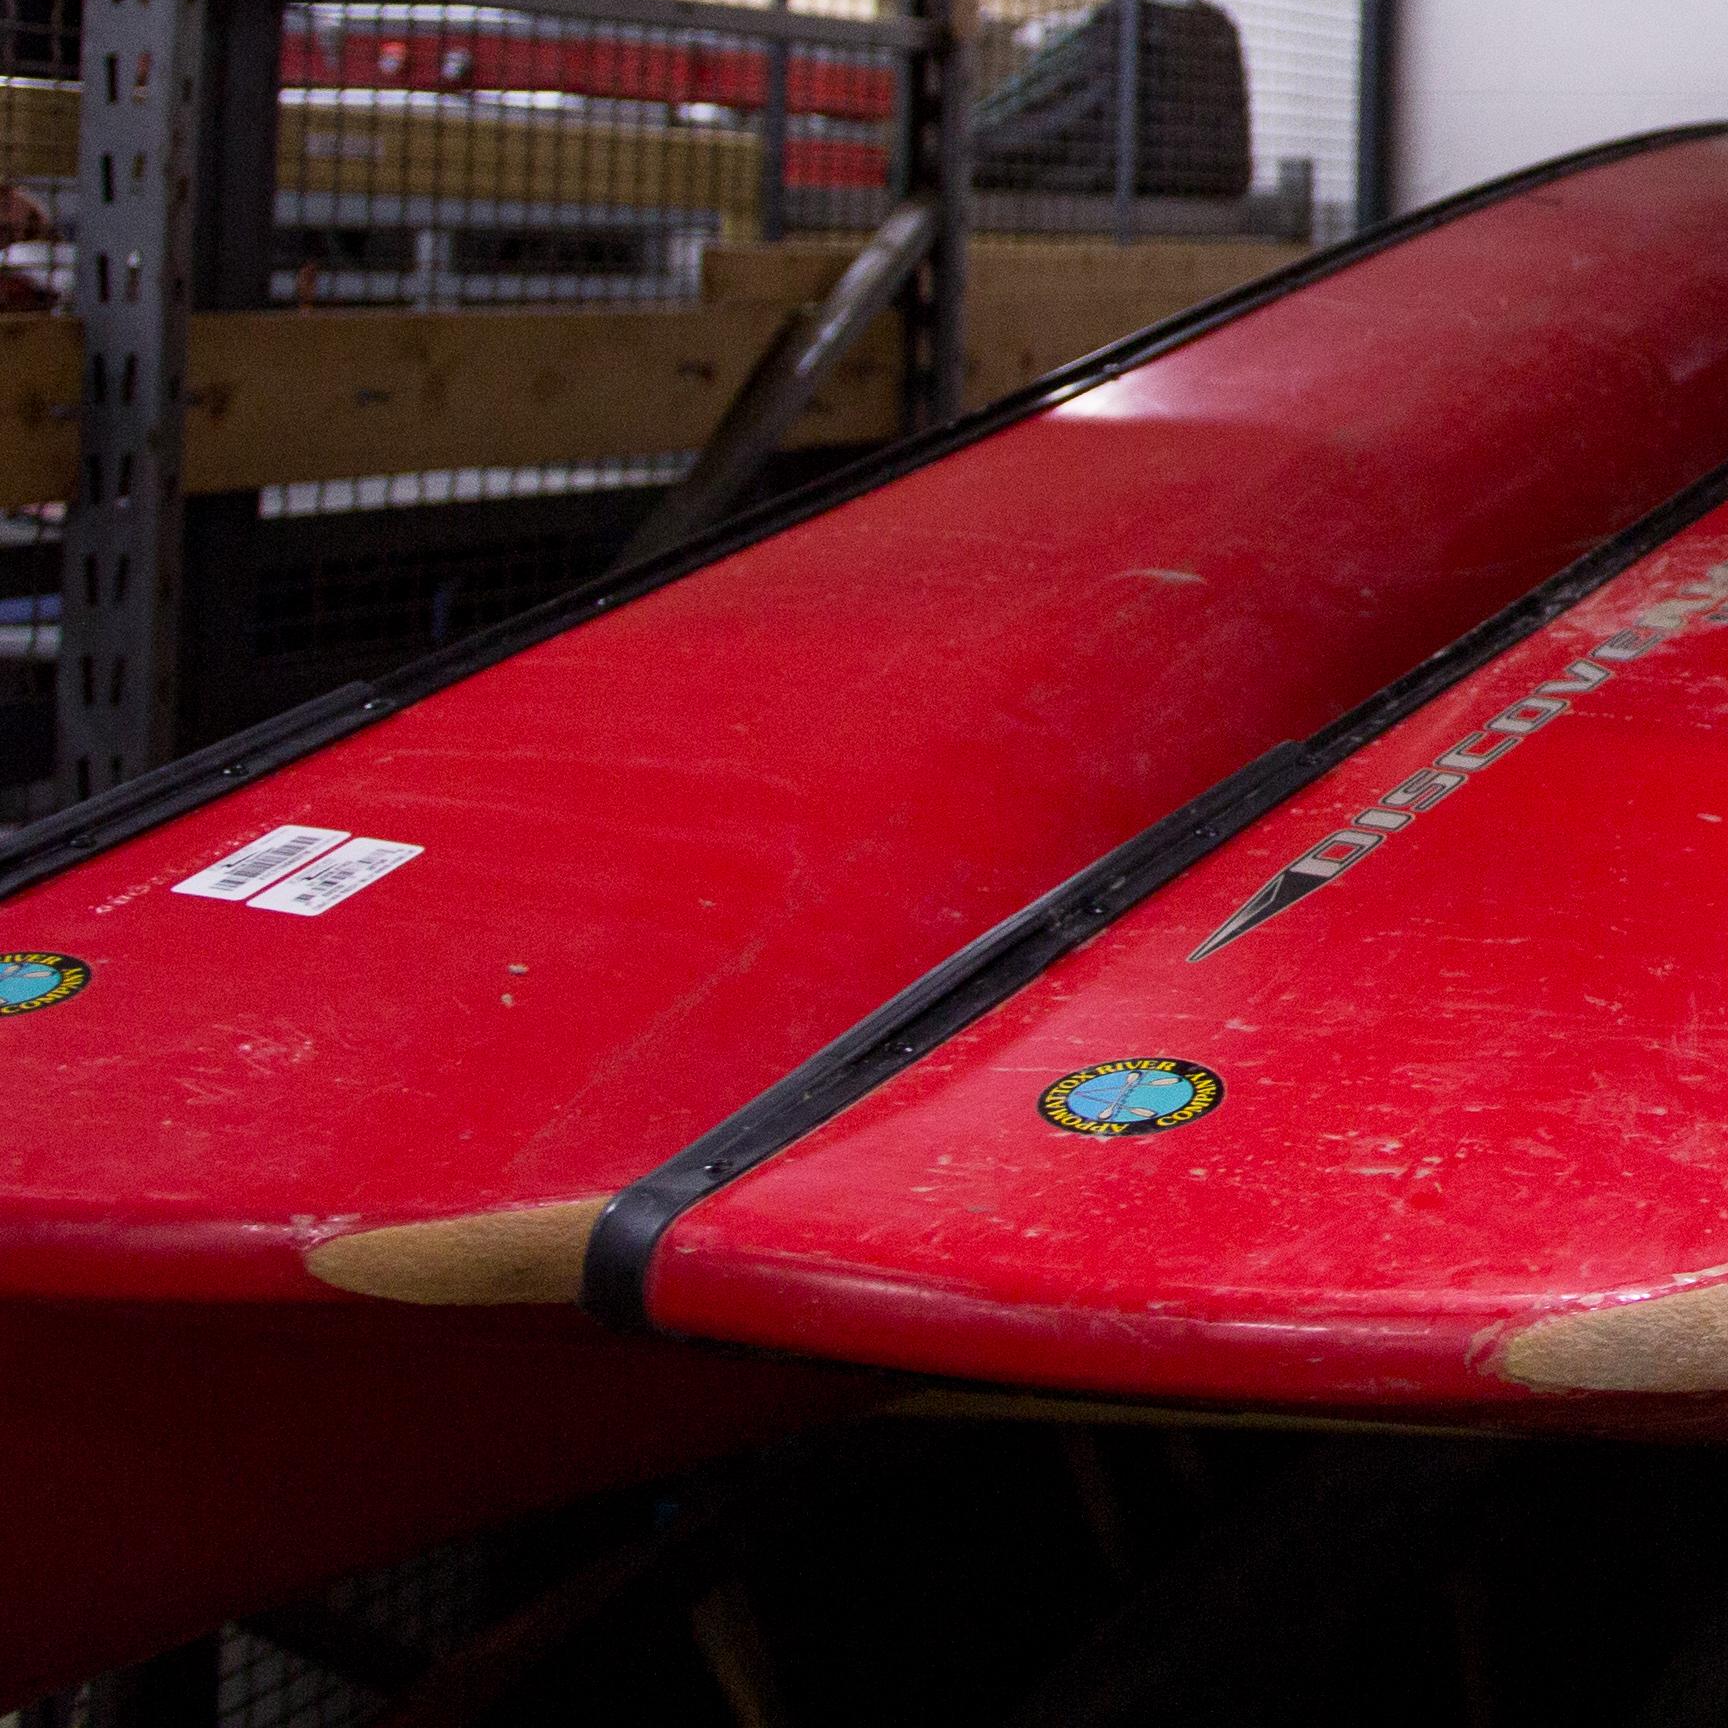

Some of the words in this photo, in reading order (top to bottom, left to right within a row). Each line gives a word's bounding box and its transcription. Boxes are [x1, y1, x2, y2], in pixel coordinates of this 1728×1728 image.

[0, 953, 63, 966] IVER
[1044, 1071, 1130, 1134] APPOMATTOX
[1096, 1059, 1177, 1075] RIVER
[1155, 1071, 1218, 1127] COMPANY
